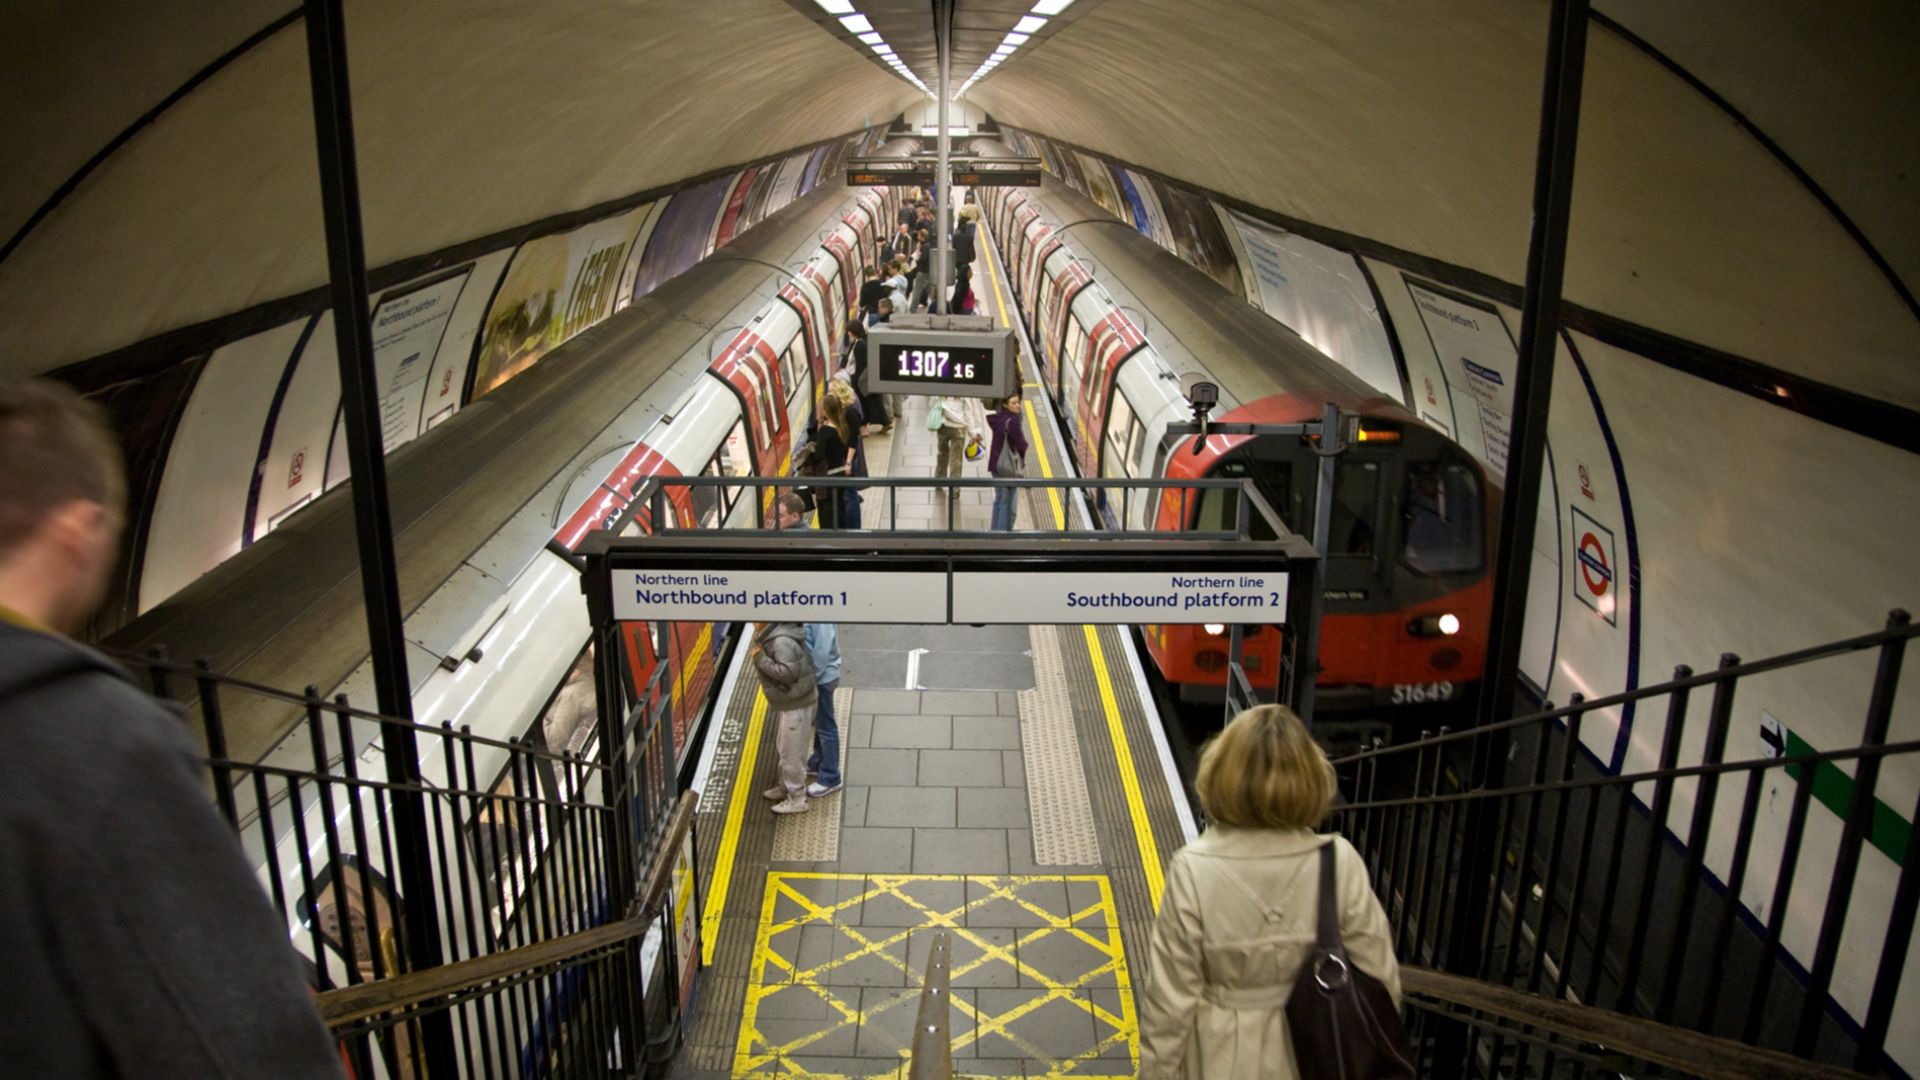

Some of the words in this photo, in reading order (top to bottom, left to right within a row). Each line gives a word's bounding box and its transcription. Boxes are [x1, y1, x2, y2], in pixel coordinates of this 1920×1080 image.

[898, 350, 950, 378] 1307
[953, 362, 975, 379] 16
[635, 573, 699, 586] Northern
[703, 574, 729, 587] line
[1171, 576, 1235, 588] Northern
[1239, 576, 1265, 589] line
[635, 589, 747, 605] Northbound
[753, 591, 834, 608] platform
[840, 591, 848, 606] 1
[1066, 592, 1178, 608] Southbound
[1184, 592, 1264, 610] platform
[1270, 593, 1280, 607] 2
[1391, 680, 1455, 705] 51649
[720, 718, 744, 743] GAP
[711, 747, 738, 772] THE
[700, 776, 730, 814] MIND
